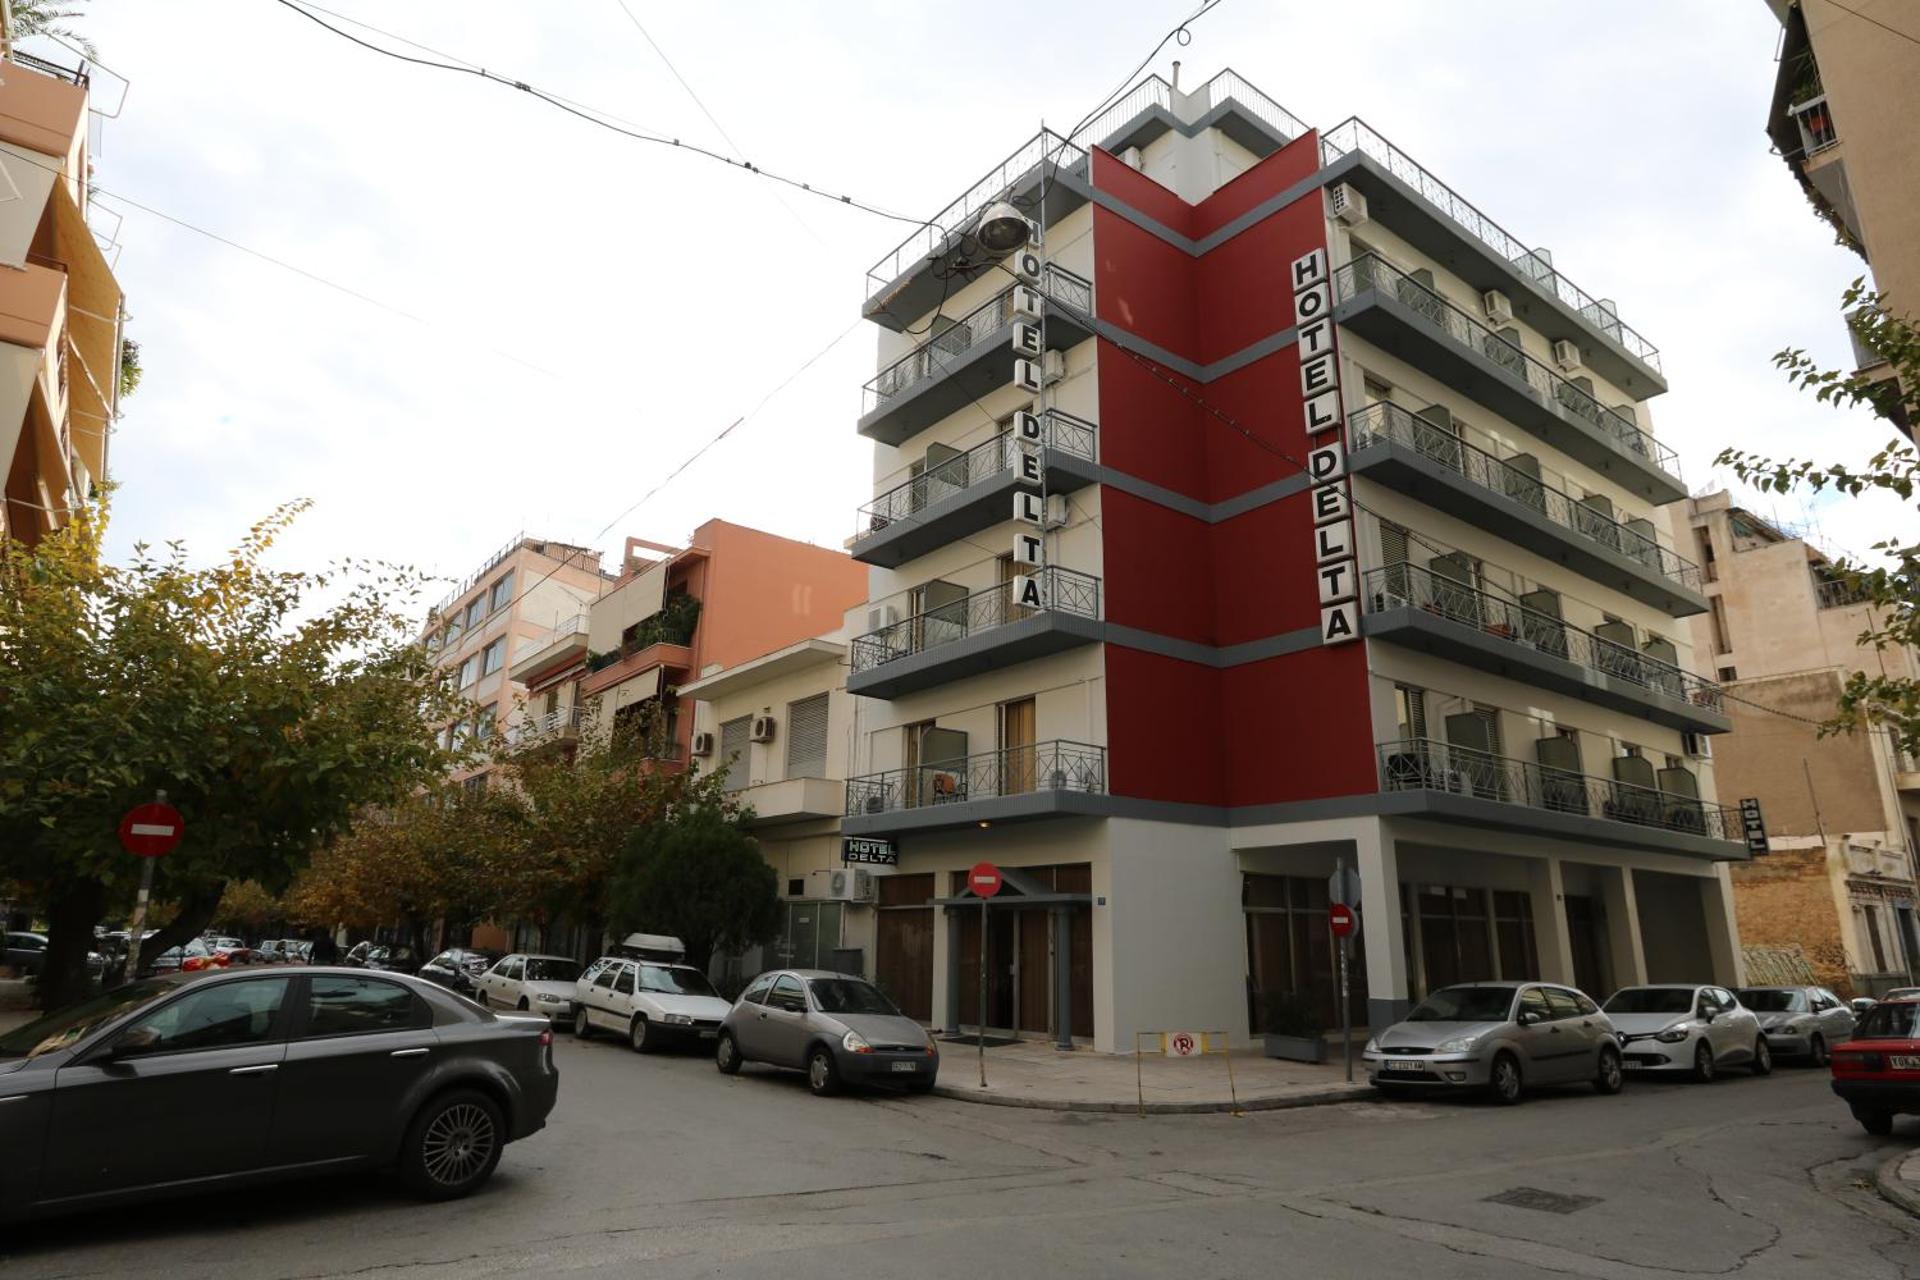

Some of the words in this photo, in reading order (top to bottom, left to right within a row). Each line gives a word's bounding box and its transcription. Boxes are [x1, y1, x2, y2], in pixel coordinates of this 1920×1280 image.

[1294, 253, 1333, 429] HOTEL
[1020, 413, 1041, 607] DELTA
[1311, 450, 1353, 640] DELTA
[847, 852, 897, 864] DELTA
[848, 840, 897, 856] HOTEL
[1741, 799, 1766, 850] HOTEL
